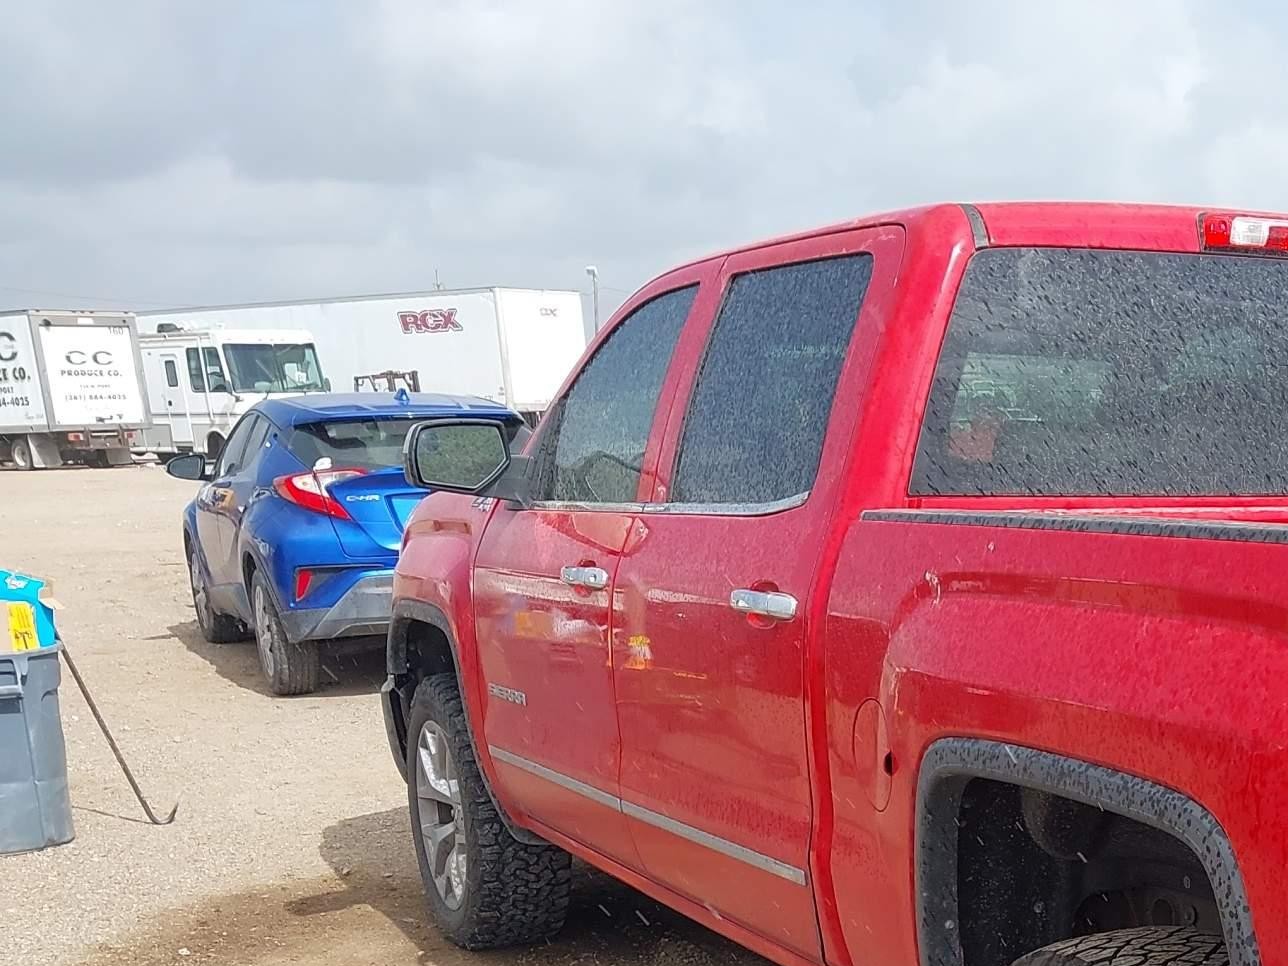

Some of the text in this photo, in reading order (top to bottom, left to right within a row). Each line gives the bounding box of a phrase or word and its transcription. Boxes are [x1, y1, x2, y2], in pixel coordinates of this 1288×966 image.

[397, 308, 464, 334] RCX
[13, 366, 31, 381] CO.
[60, 369, 104, 377] PRODUCE
[488, 681, 528, 706] SIERRA
